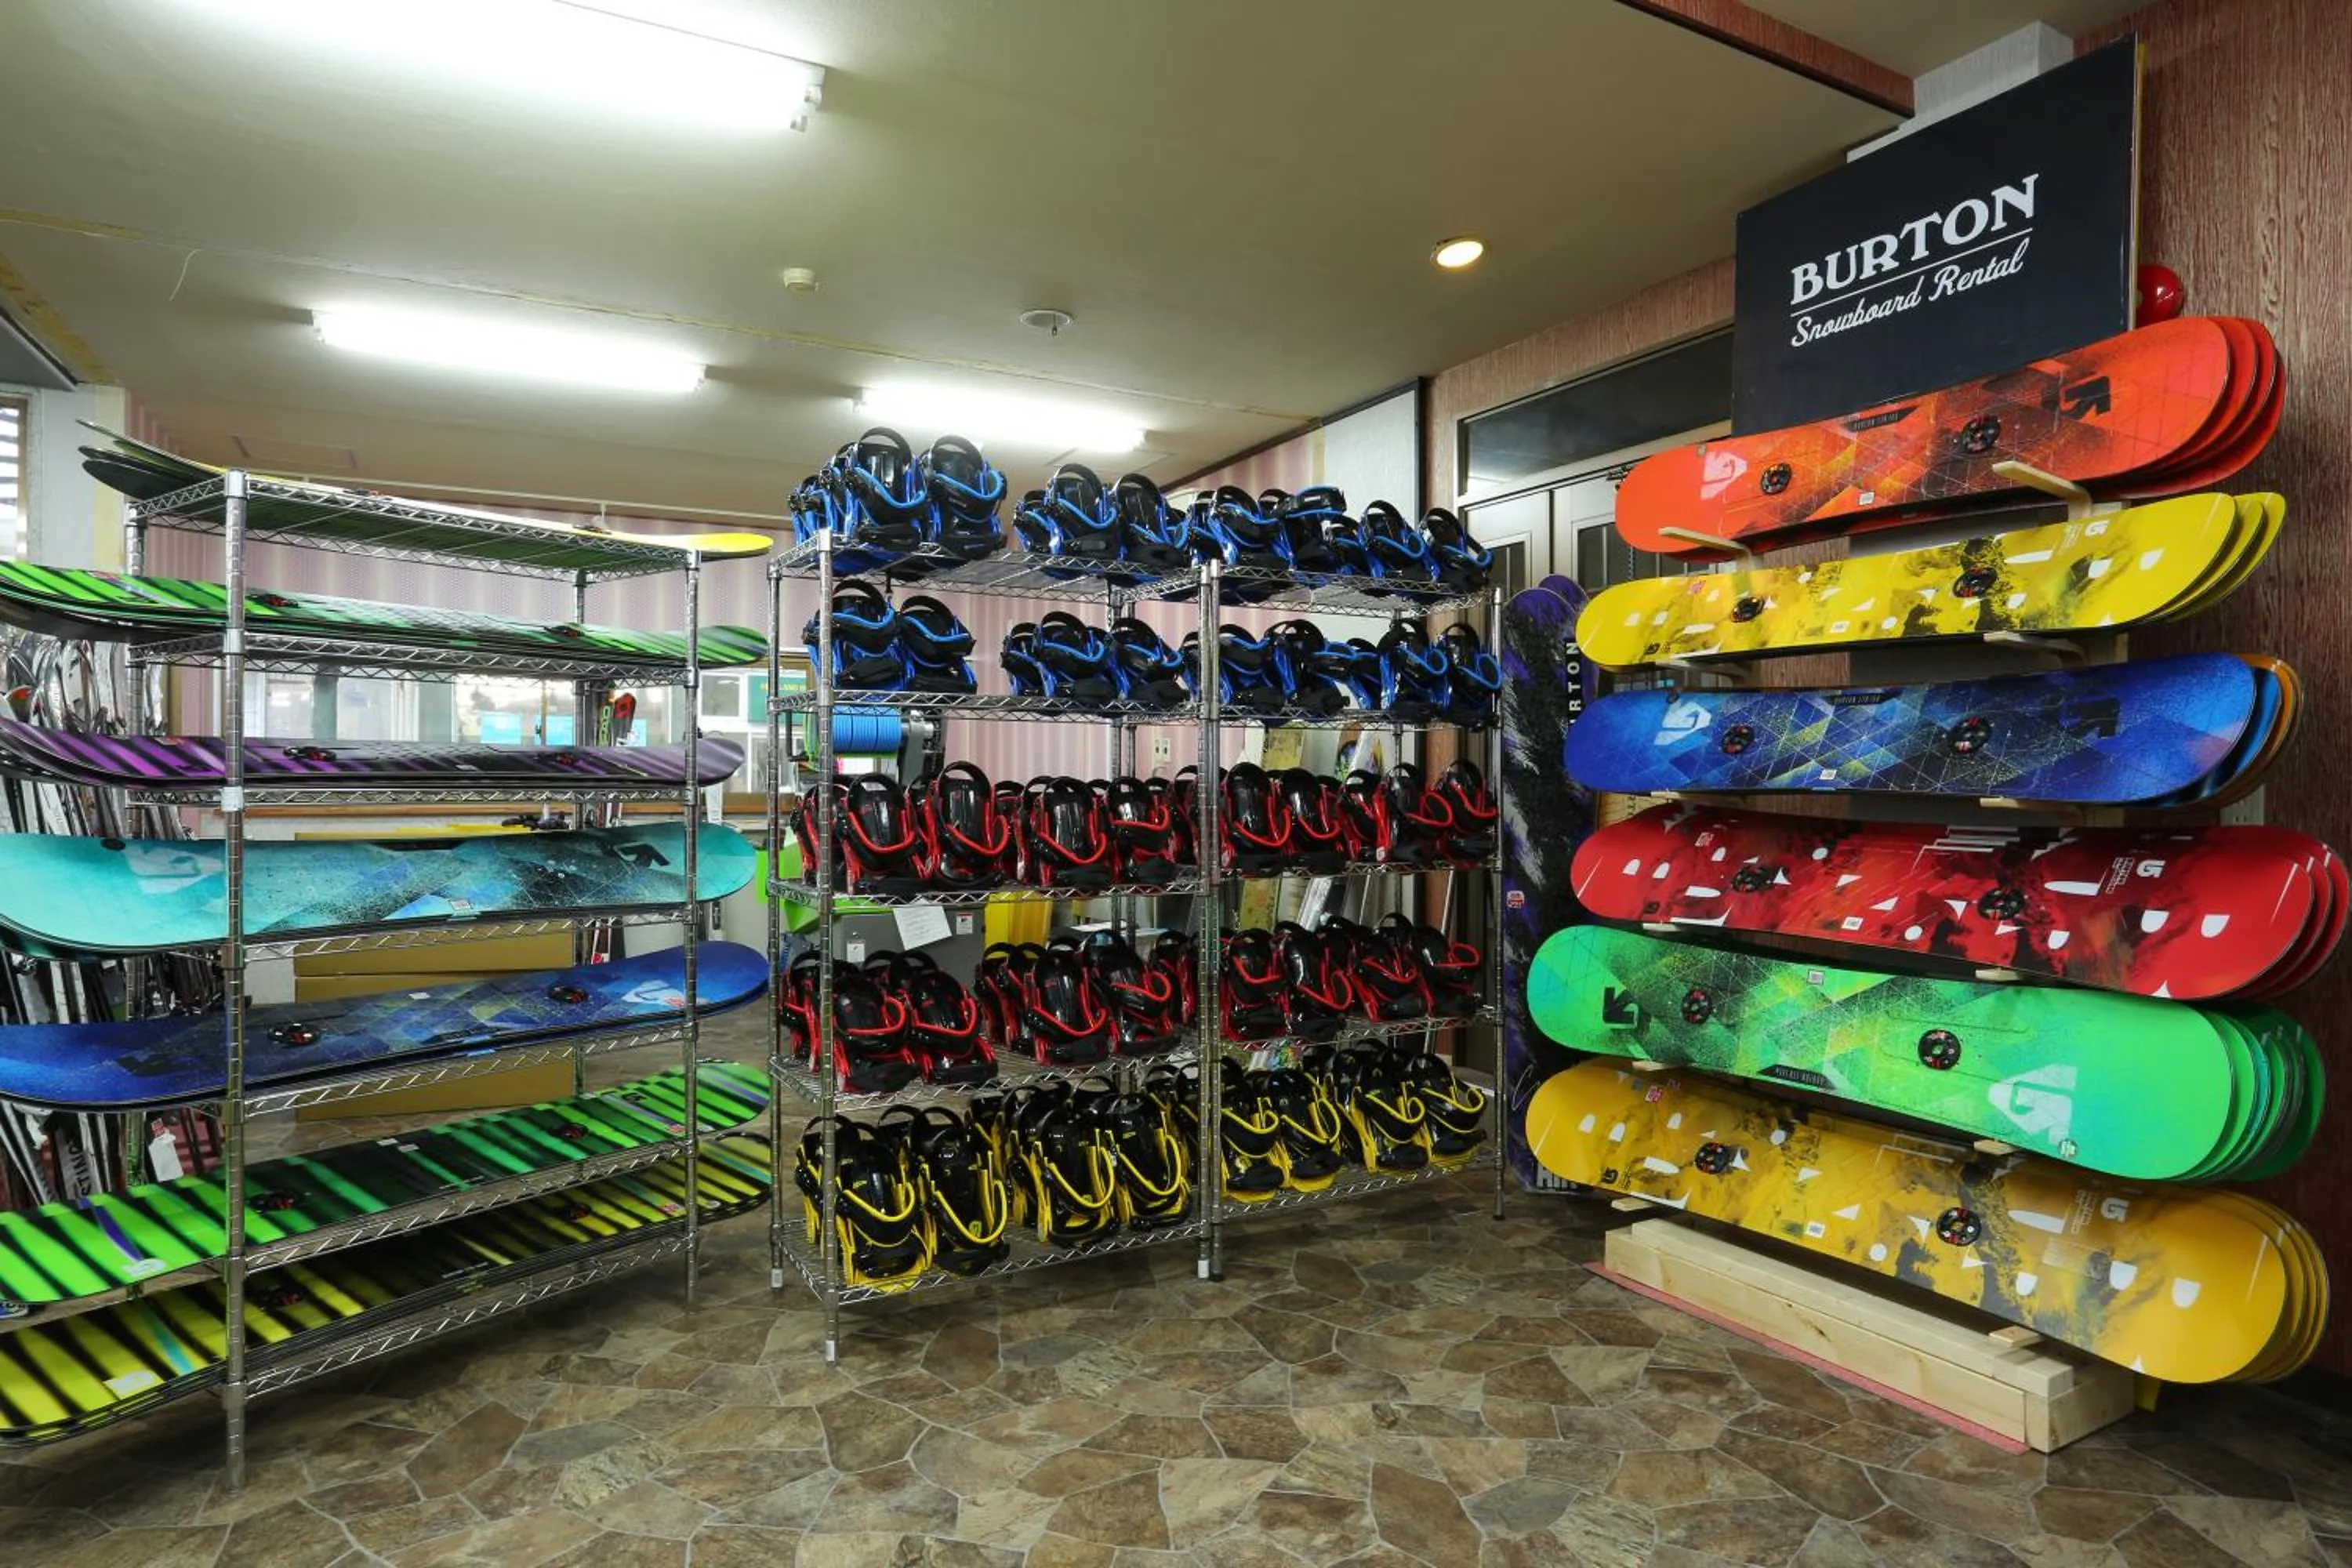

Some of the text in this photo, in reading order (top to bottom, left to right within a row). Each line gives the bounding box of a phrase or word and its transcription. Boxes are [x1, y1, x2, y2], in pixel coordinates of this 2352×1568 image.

[1791, 173, 2038, 305] BURTON
[1791, 238, 2030, 347] Snowboard Rental
[1566, 642, 1582, 724] RTON
